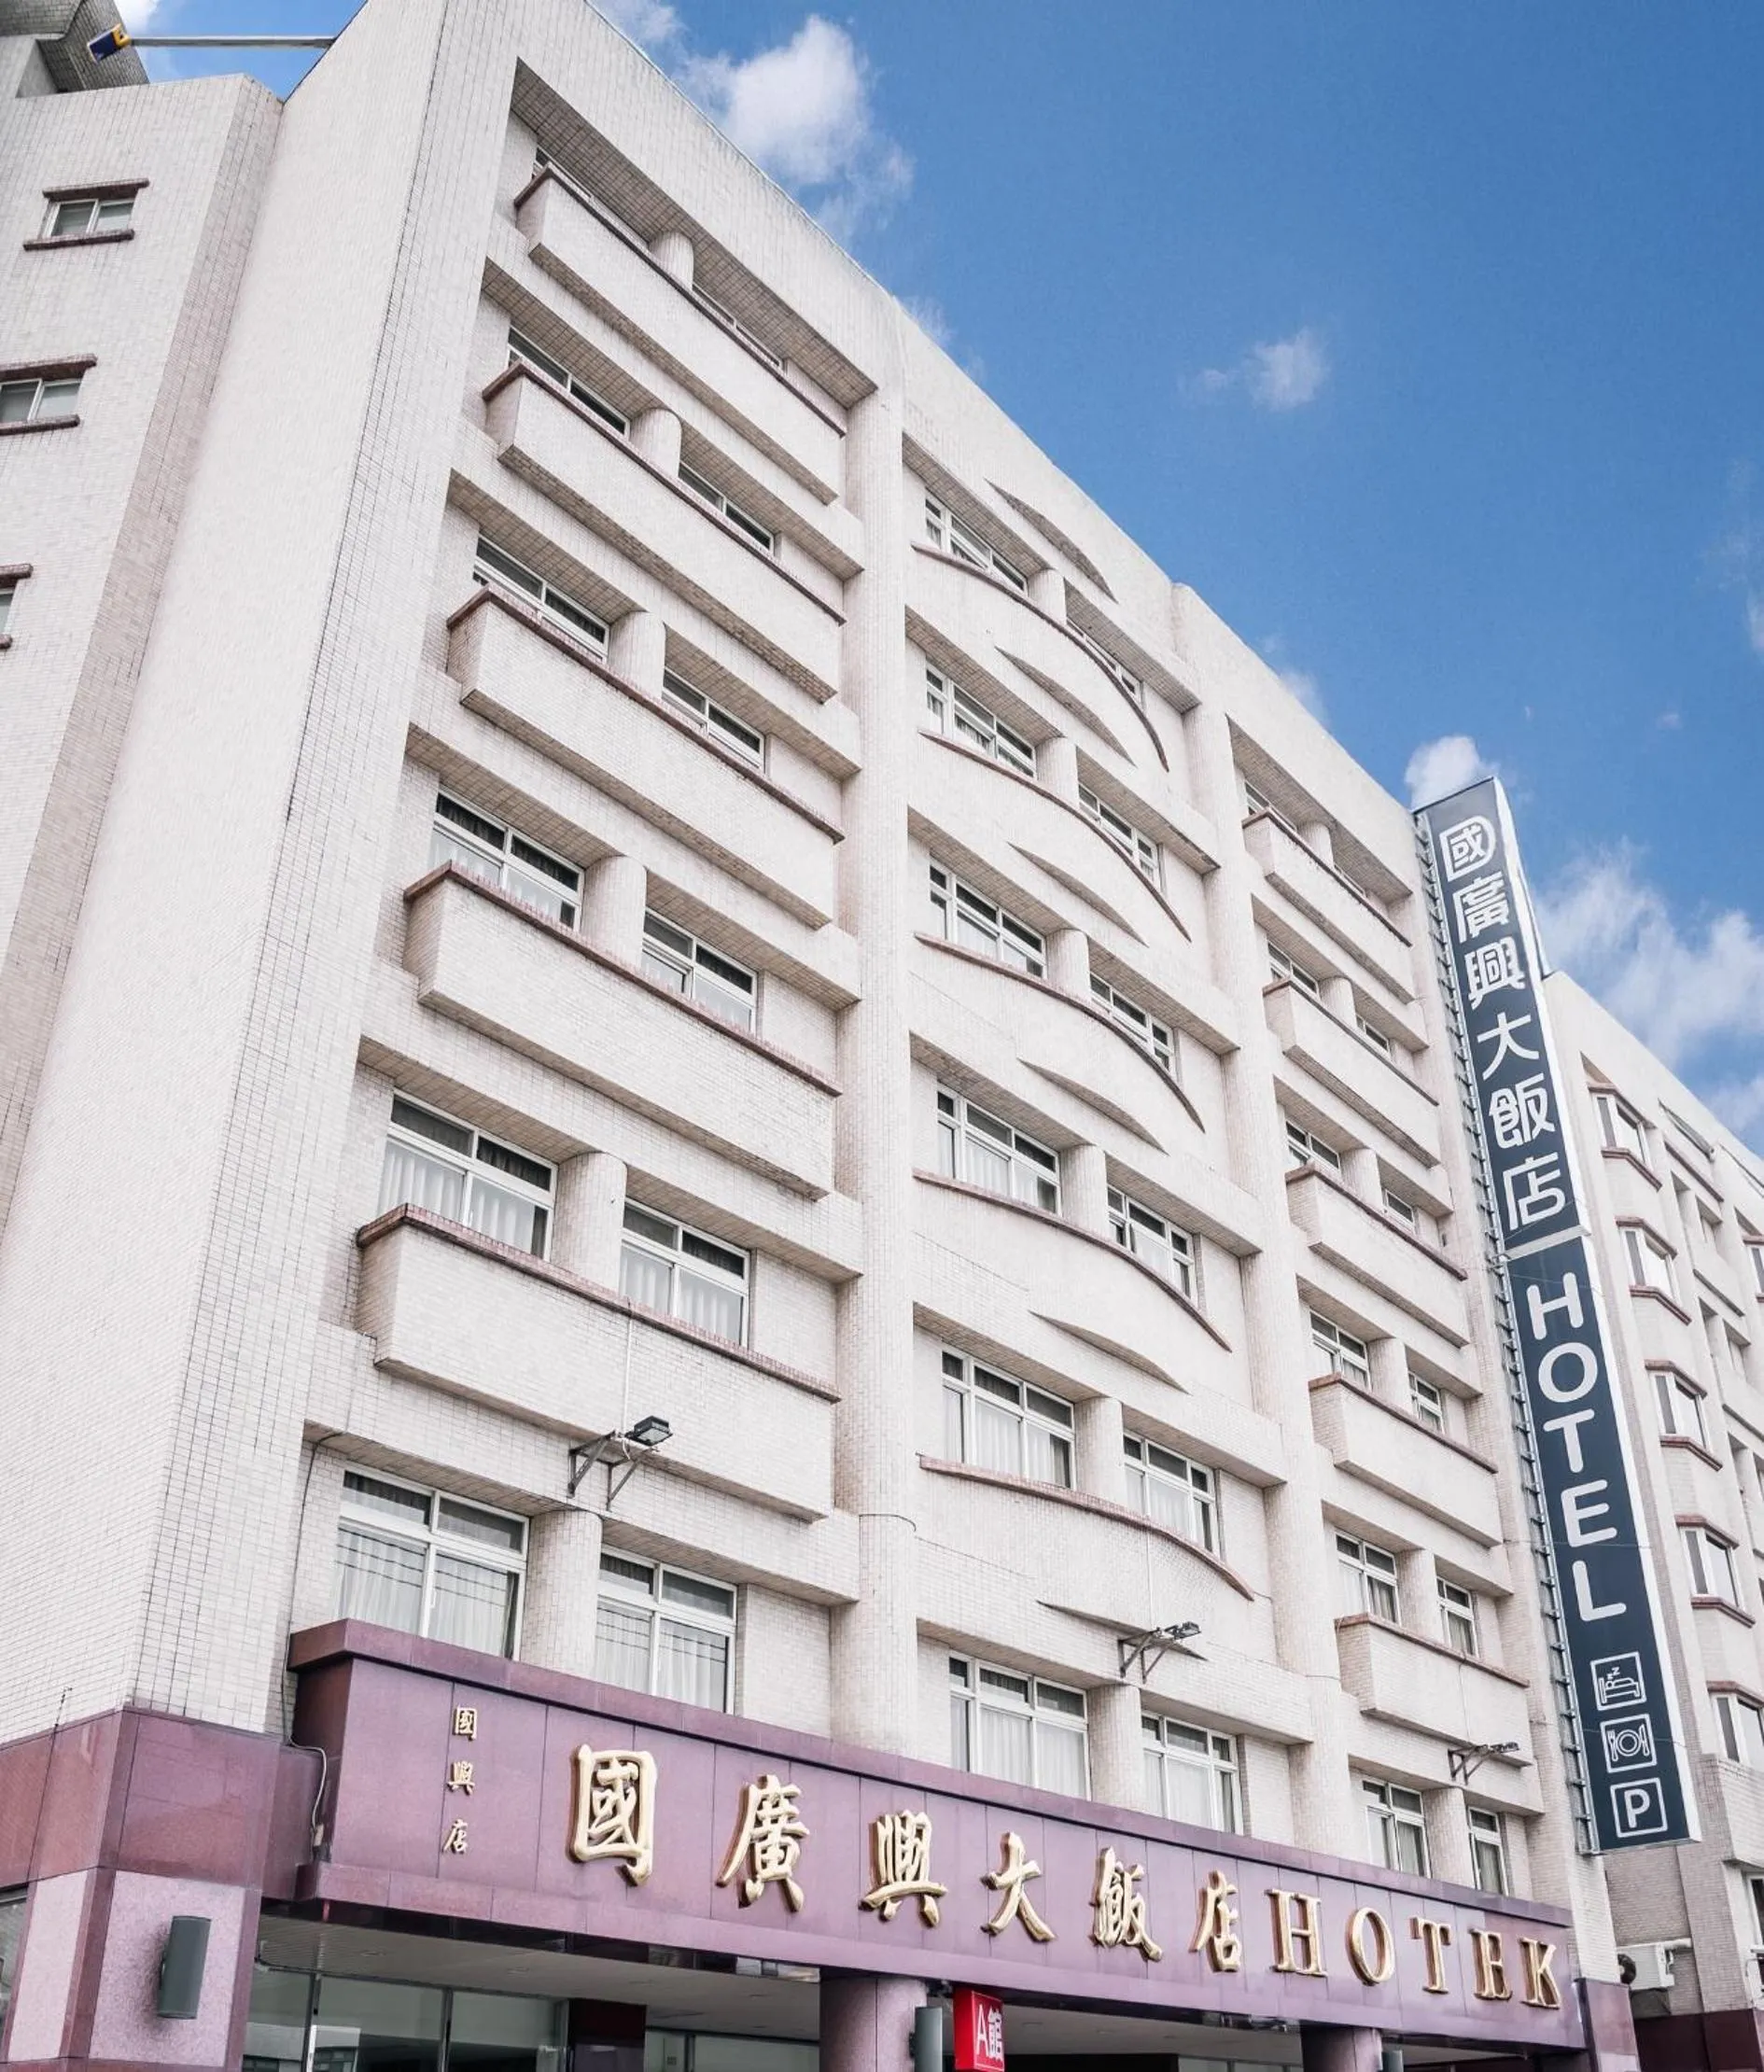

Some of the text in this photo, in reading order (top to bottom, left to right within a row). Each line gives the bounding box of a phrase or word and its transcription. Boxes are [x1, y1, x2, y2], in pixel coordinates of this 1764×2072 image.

[1438, 814, 1567, 1231] 國廣興大飯店
[1525, 1271, 1627, 1622] HOTEL
[442, 1703, 478, 1855] 國興店
[567, 1743, 1242, 1973] 國廣興大飯店
[1624, 1787, 1651, 1829] P
